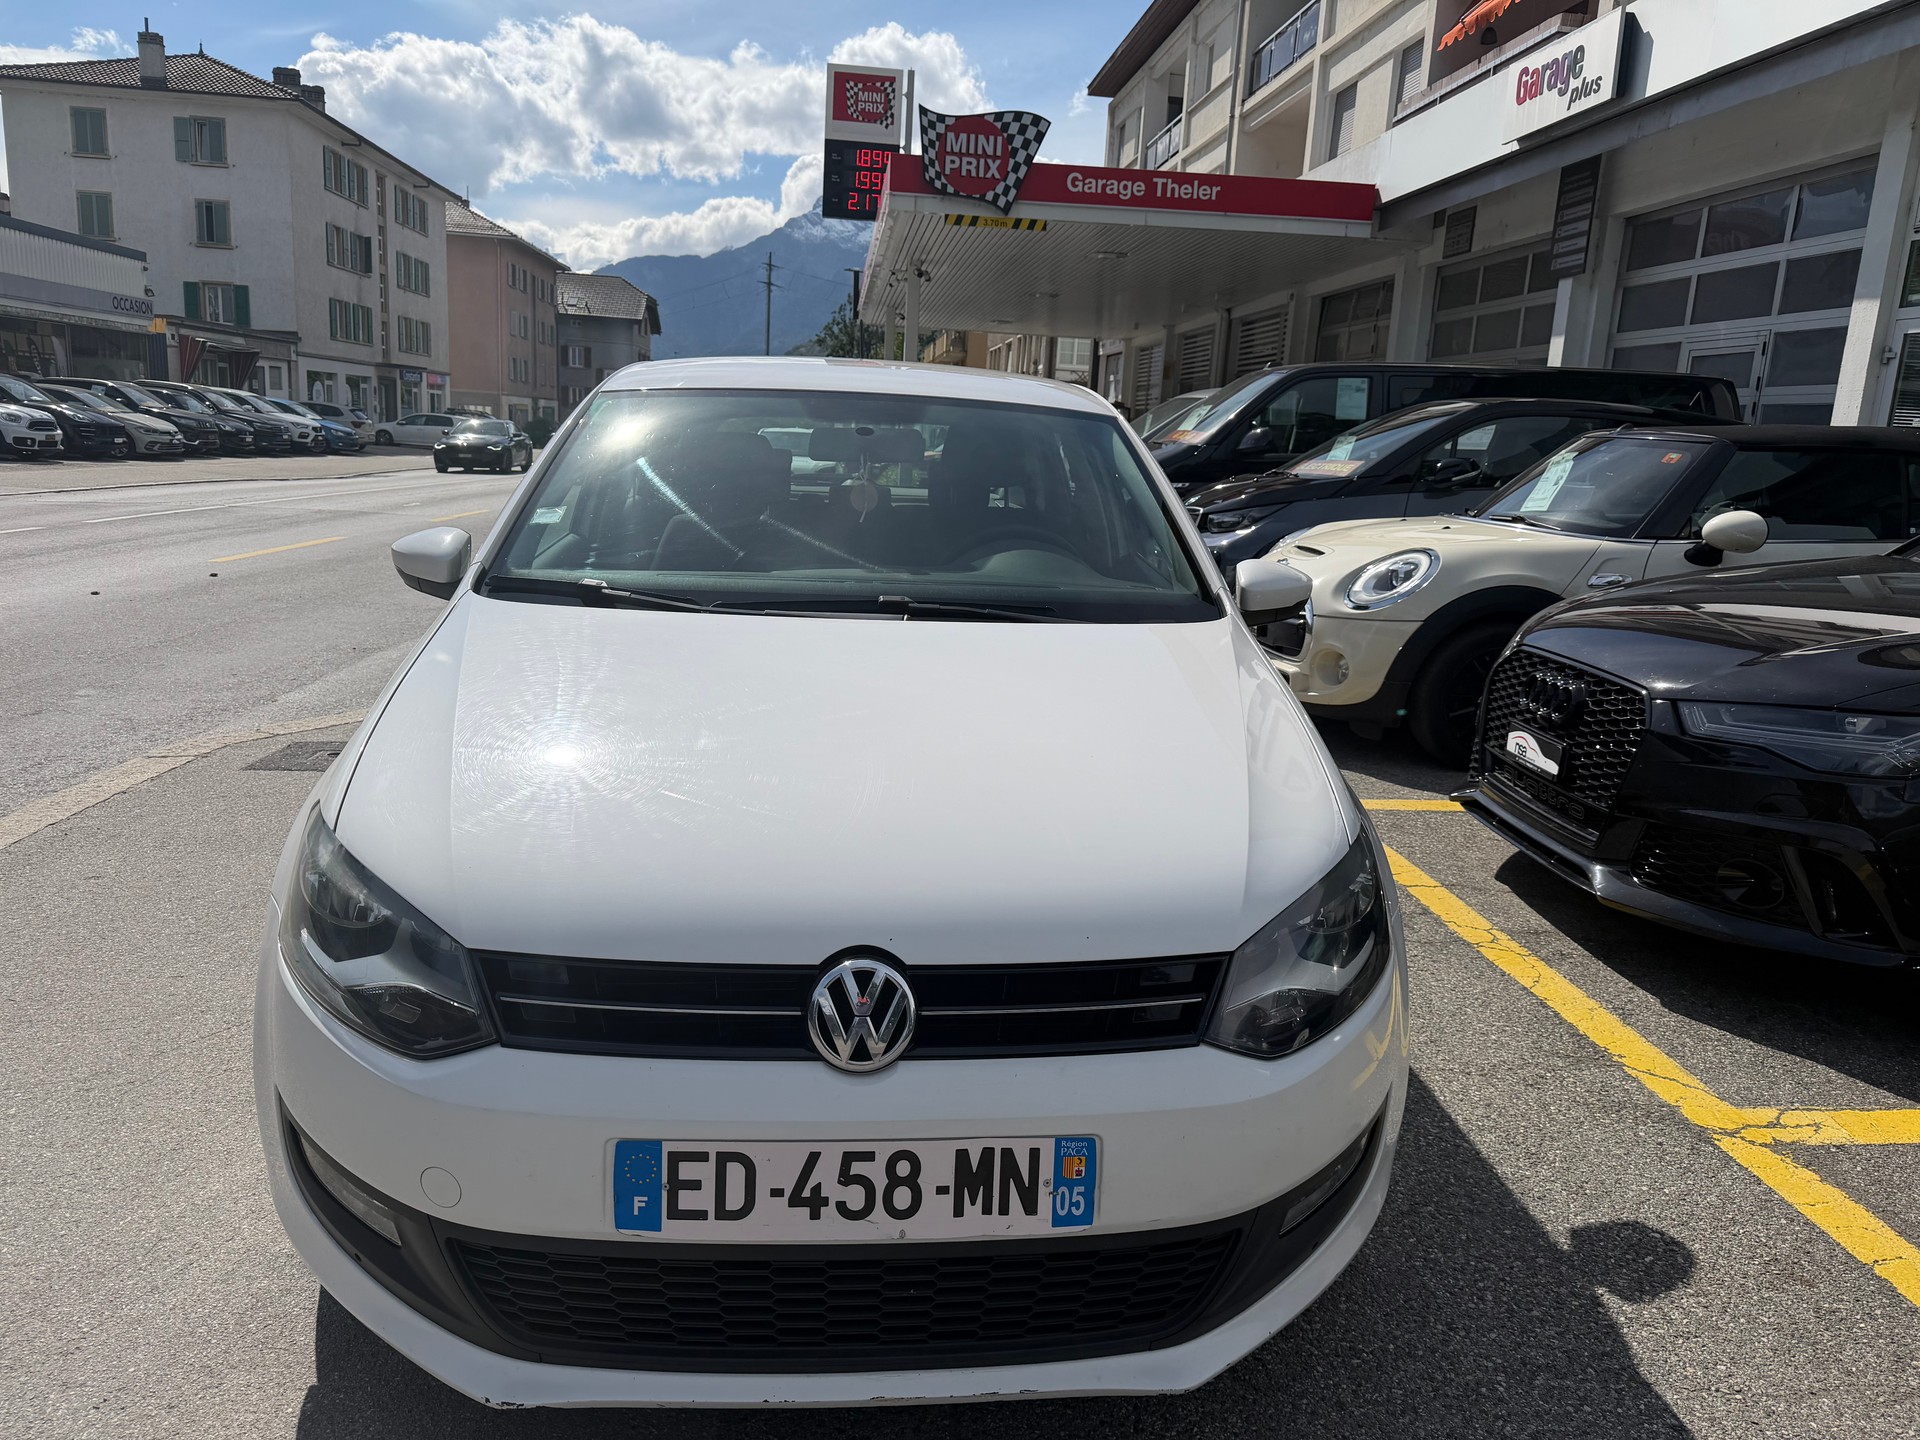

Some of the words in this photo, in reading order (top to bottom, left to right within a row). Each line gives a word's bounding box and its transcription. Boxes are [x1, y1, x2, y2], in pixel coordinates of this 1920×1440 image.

[1516, 44, 1585, 106] Garage
[858, 91, 885, 103] MINI
[1567, 75, 1602, 111] plus
[857, 102, 885, 114] PRIX
[945, 131, 1003, 157] MINI
[944, 155, 1002, 180] PRIX
[1066, 172, 1146, 200] Garage
[1152, 177, 1222, 201] Theler
[112, 296, 153, 316] OCCASION
[1061, 1140, 1088, 1149] Région
[1061, 1148, 1088, 1156] PACA
[667, 1147, 1041, 1221] ED-458-MN
[633, 1196, 648, 1216] F
[1056, 1186, 1085, 1216] 05
